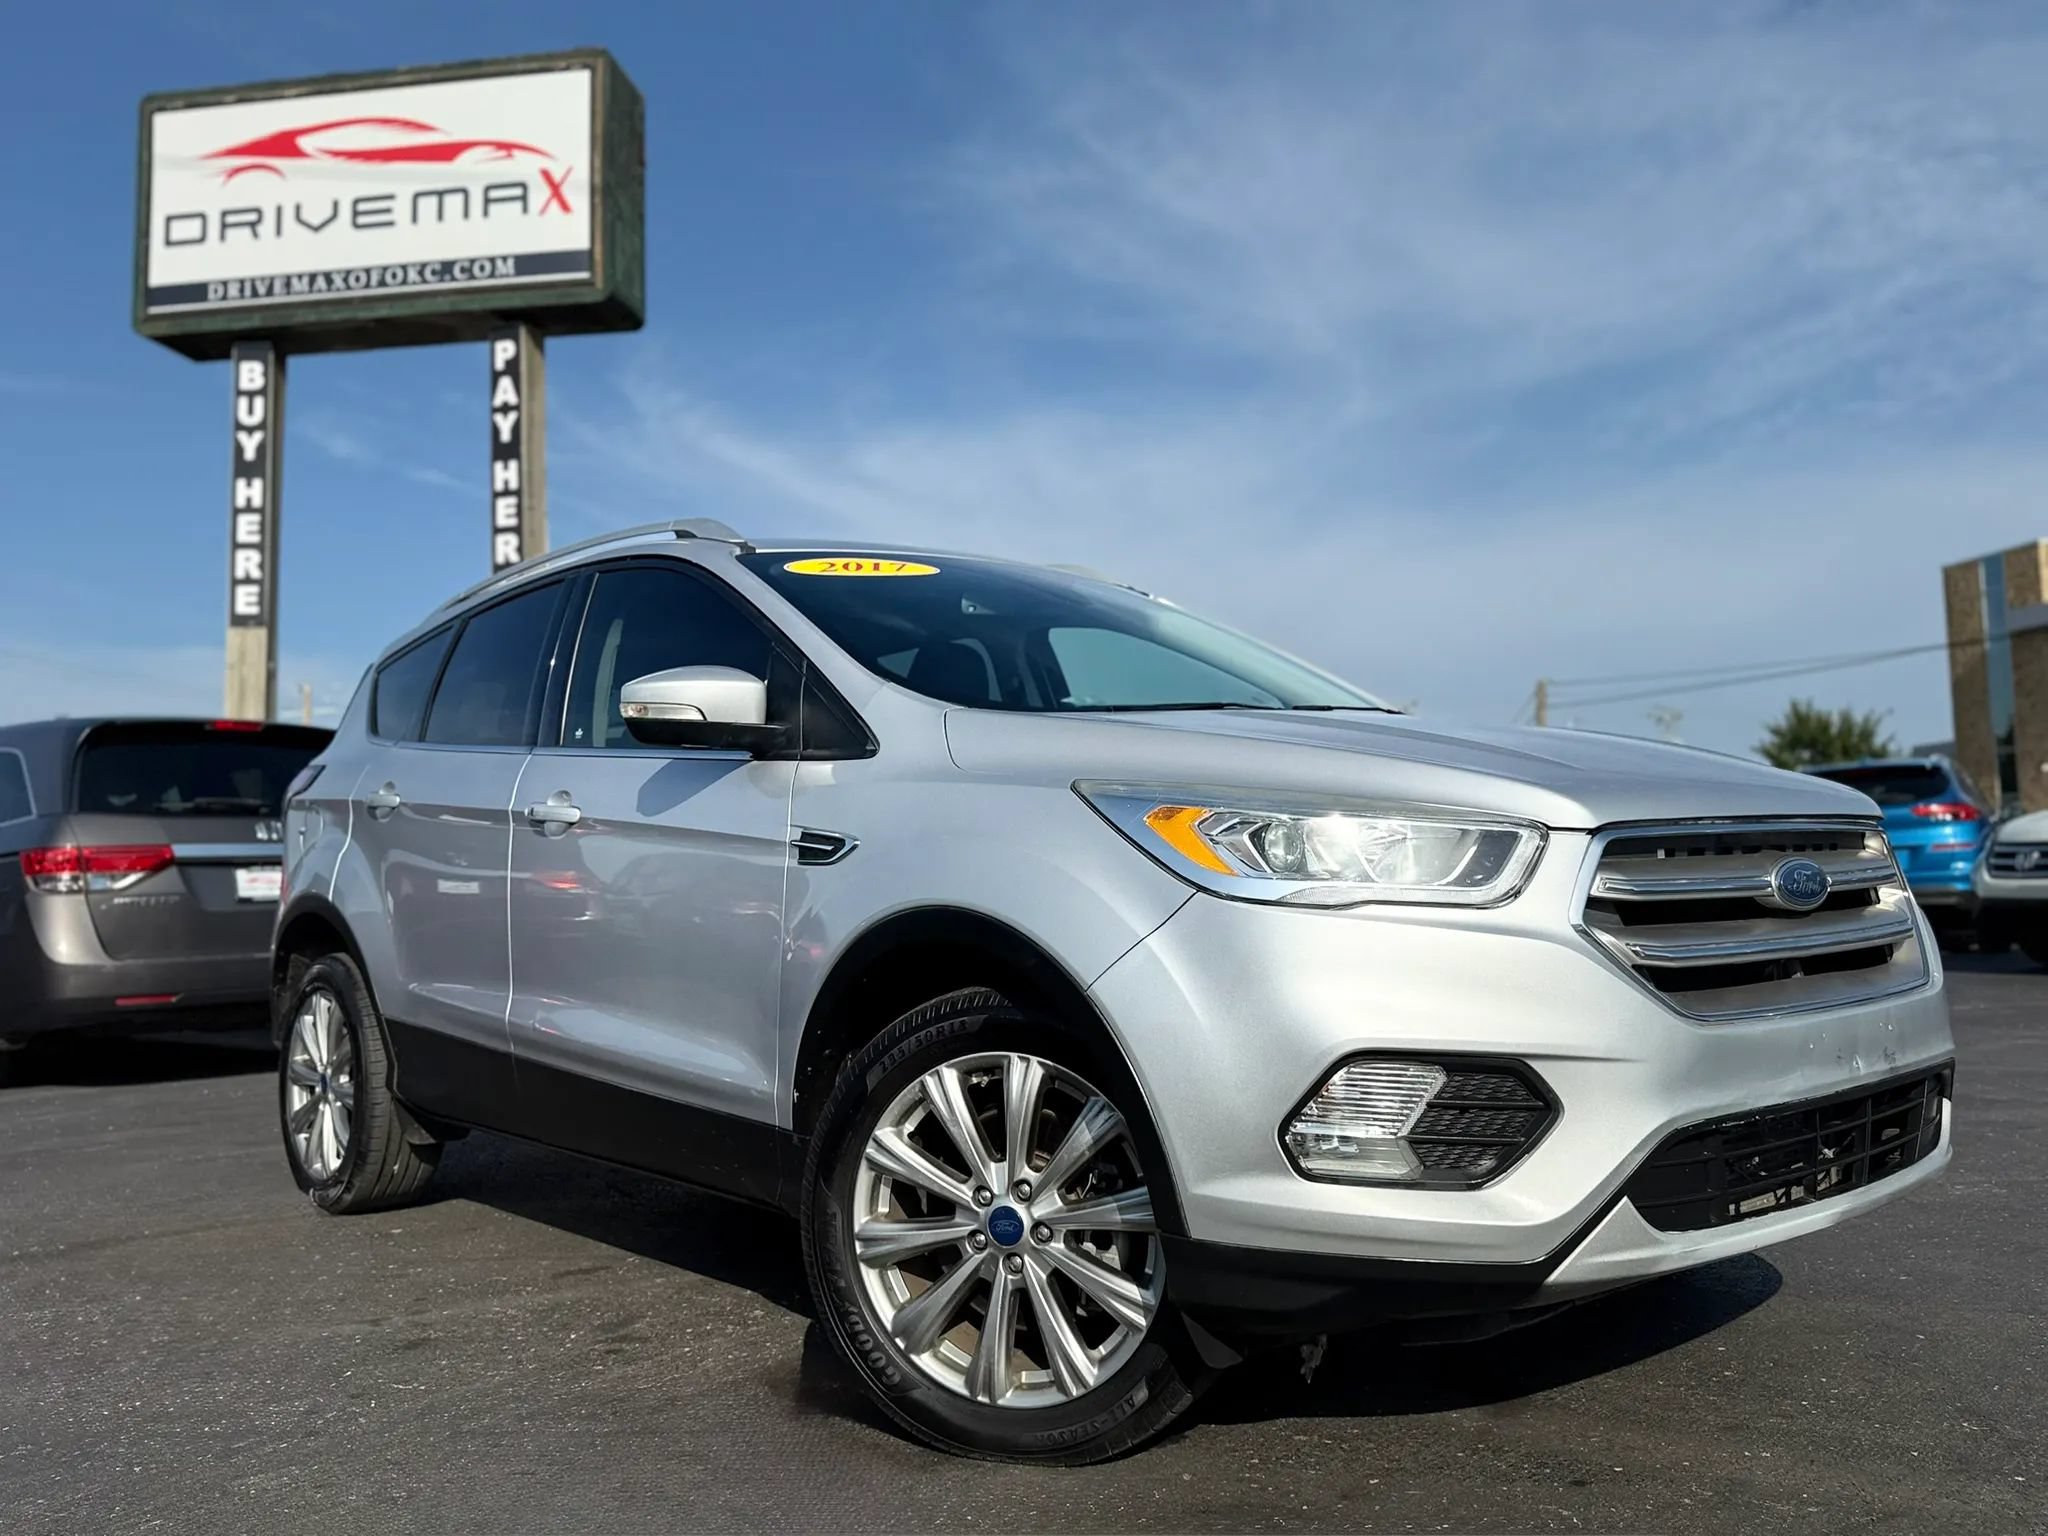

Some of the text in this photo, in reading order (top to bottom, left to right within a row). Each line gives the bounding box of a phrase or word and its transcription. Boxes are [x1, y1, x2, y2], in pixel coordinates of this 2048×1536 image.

[164, 166, 574, 247] DRIVEMAX
[206, 256, 517, 302] DRIVEMAXOFOKC.COM
[492, 339, 521, 565] PAY HER
[234, 360, 266, 615] BUY HERE
[817, 562, 907, 573] 2017
[1788, 869, 1820, 895] Ford
